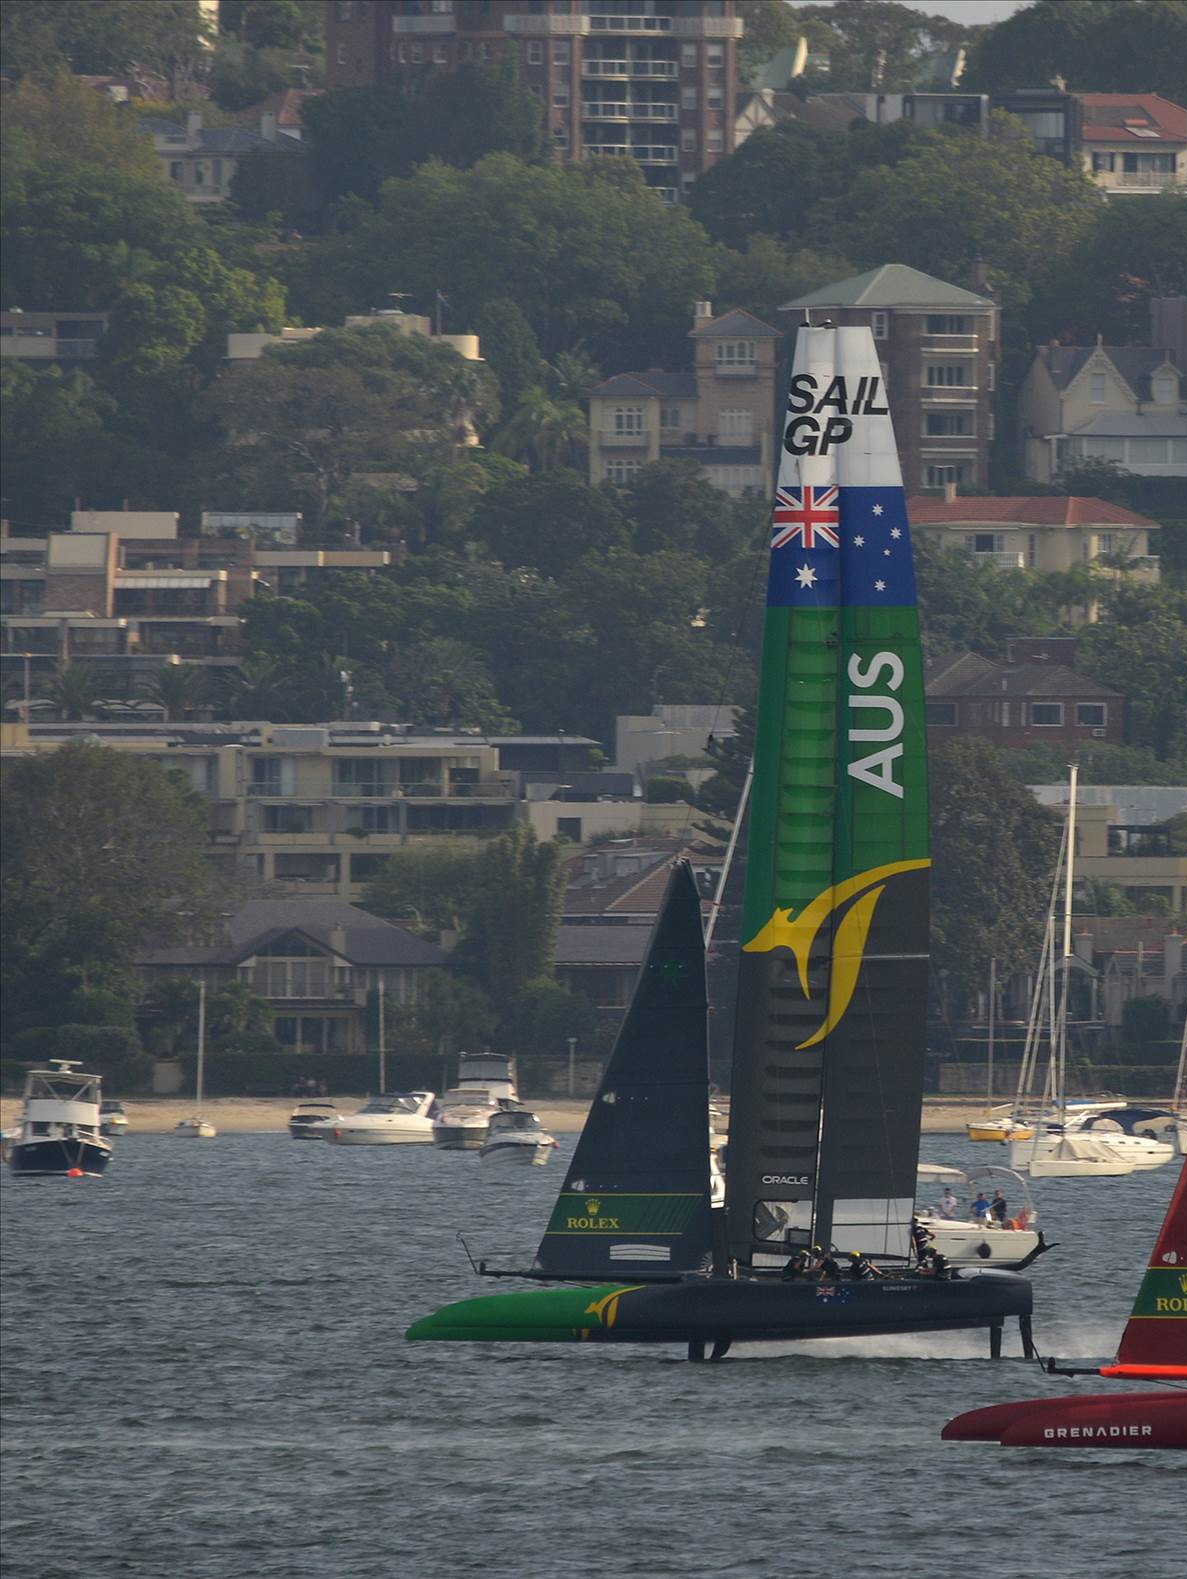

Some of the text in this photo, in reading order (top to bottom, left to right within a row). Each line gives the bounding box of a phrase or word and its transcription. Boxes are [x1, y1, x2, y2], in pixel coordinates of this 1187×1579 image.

[787, 374, 889, 415] SAIL
[783, 416, 853, 455] GP
[848, 651, 905, 799] AUS
[762, 1175, 809, 1185] ORACLE
[567, 1218, 620, 1229] ROLEX
[1043, 1424, 1152, 1438] GRENADIER
